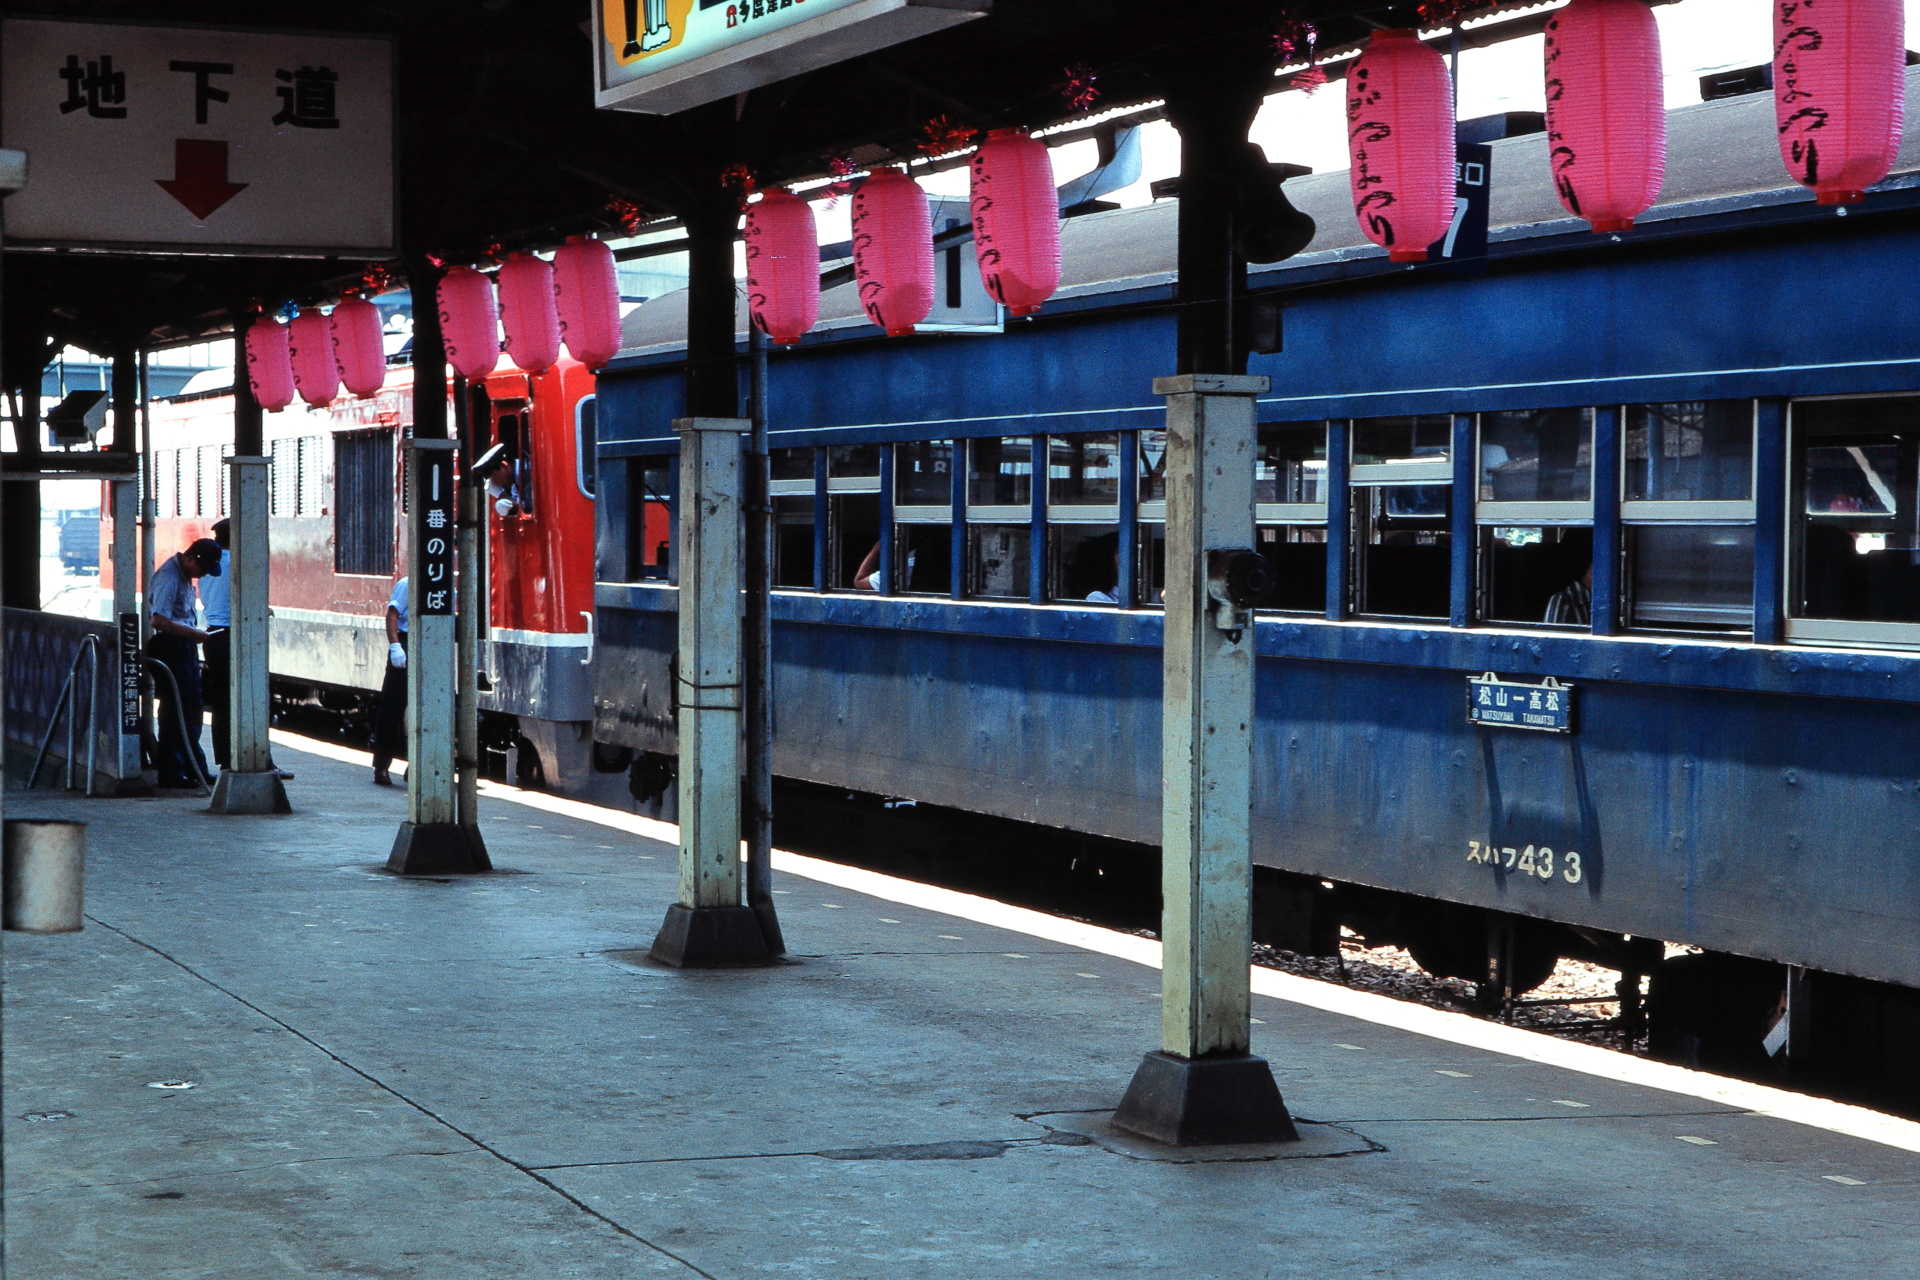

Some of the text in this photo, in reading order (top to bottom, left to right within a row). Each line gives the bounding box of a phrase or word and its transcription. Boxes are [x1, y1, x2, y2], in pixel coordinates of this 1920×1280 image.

[59, 54, 340, 129] 地下道
[1442, 197, 1469, 258] 7
[1563, 851, 1582, 884] 3
